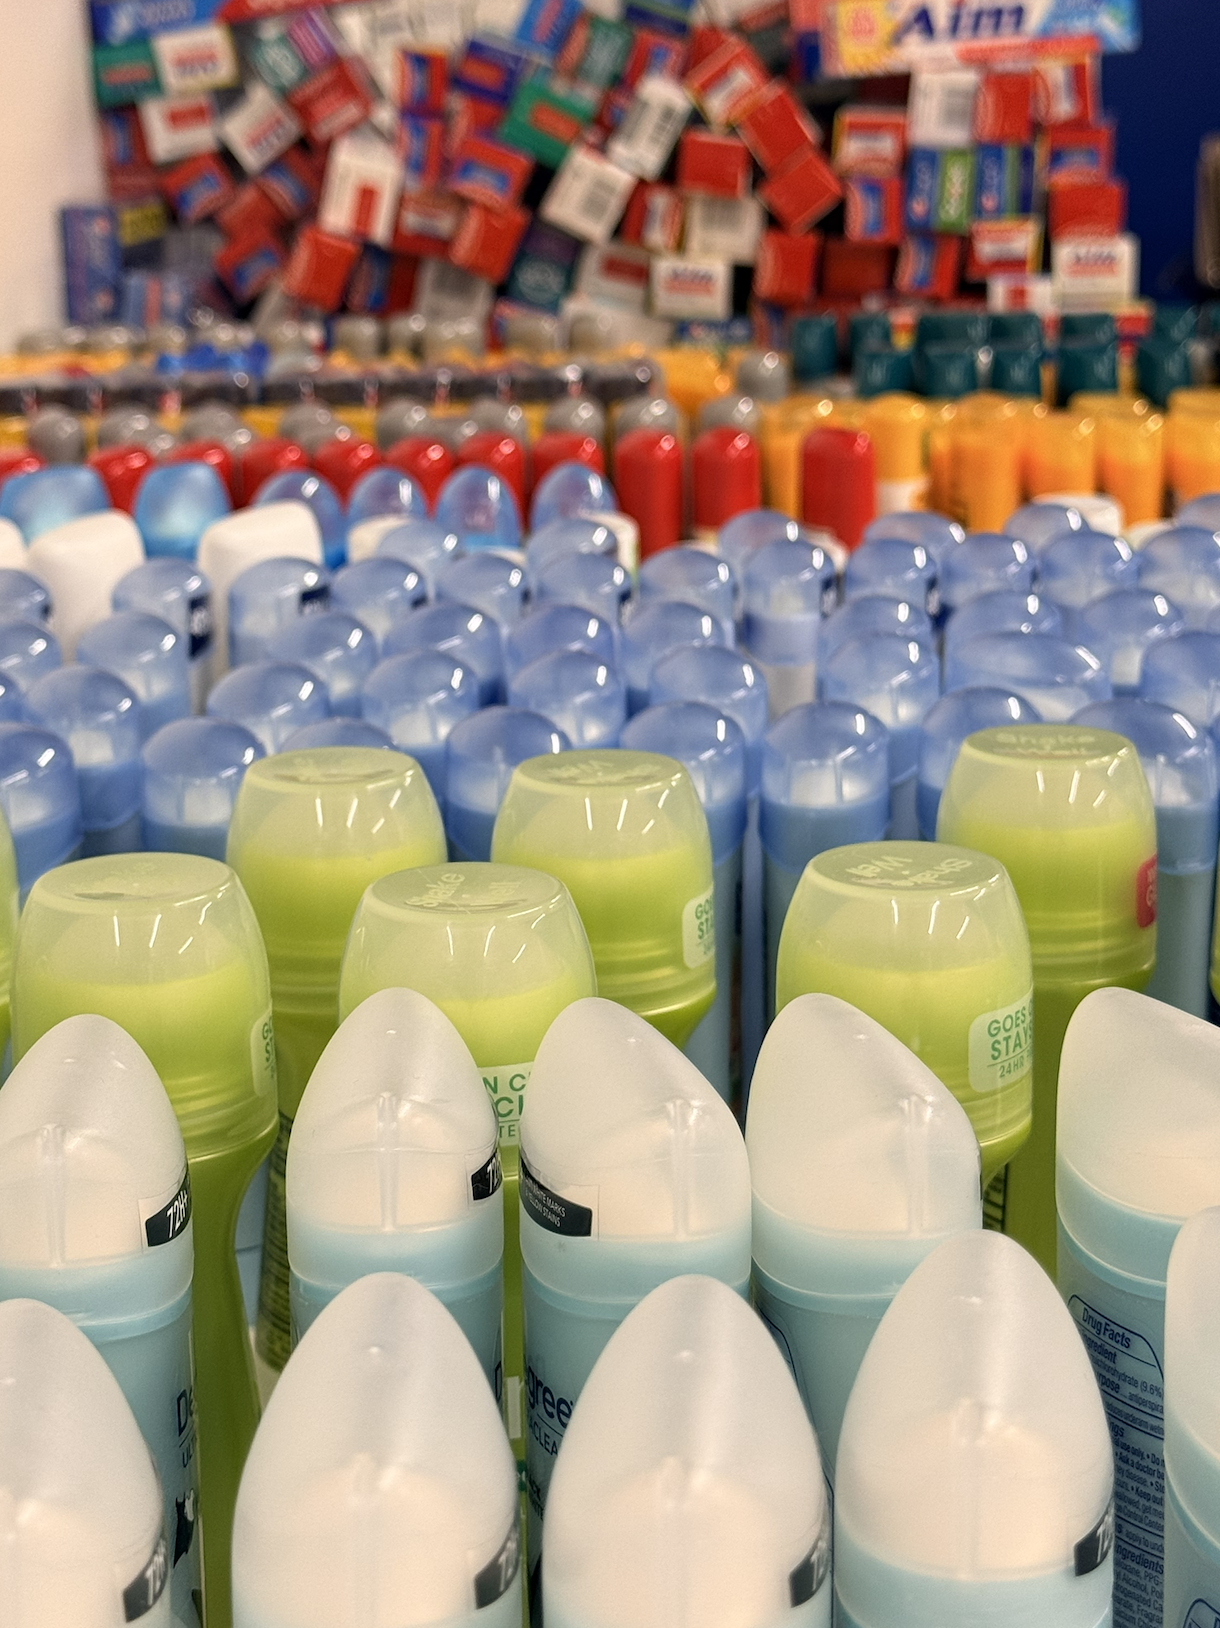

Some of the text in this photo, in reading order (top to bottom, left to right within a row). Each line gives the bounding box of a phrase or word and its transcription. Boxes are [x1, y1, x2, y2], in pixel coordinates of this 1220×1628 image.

[987, 1006, 1026, 1038] GOES
[542, 1206, 561, 1228] STAINS
[546, 1196, 566, 1218] MARKS
[1082, 1307, 1131, 1349] Drug Facts
[1128, 1391, 1164, 1414] antiperspira
